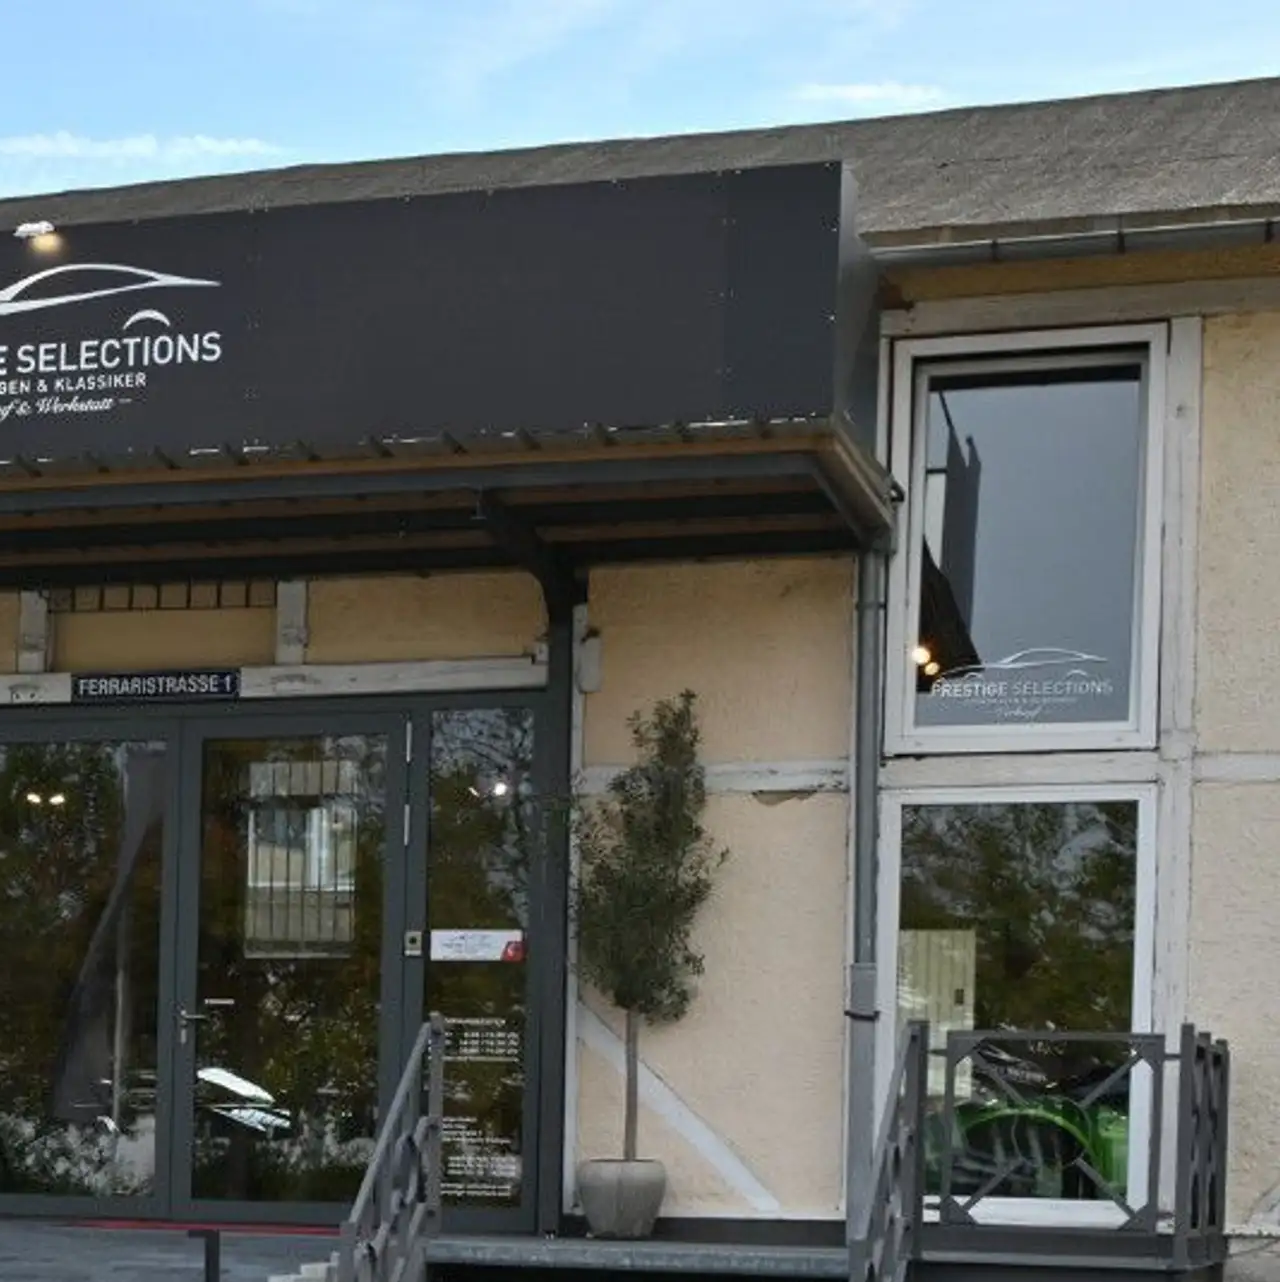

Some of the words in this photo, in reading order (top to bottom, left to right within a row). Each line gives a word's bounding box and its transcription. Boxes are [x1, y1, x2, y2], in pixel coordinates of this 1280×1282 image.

[16, 331, 222, 374] SELECTIONS
[37, 379, 48, 393] &
[54, 372, 147, 392] KLASSIKER
[79, 674, 219, 696] FERRARISTRASSE
[224, 674, 232, 692] 1
[931, 682, 1007, 698] PRESTIGE
[1012, 679, 1114, 697] SELECTIONS
